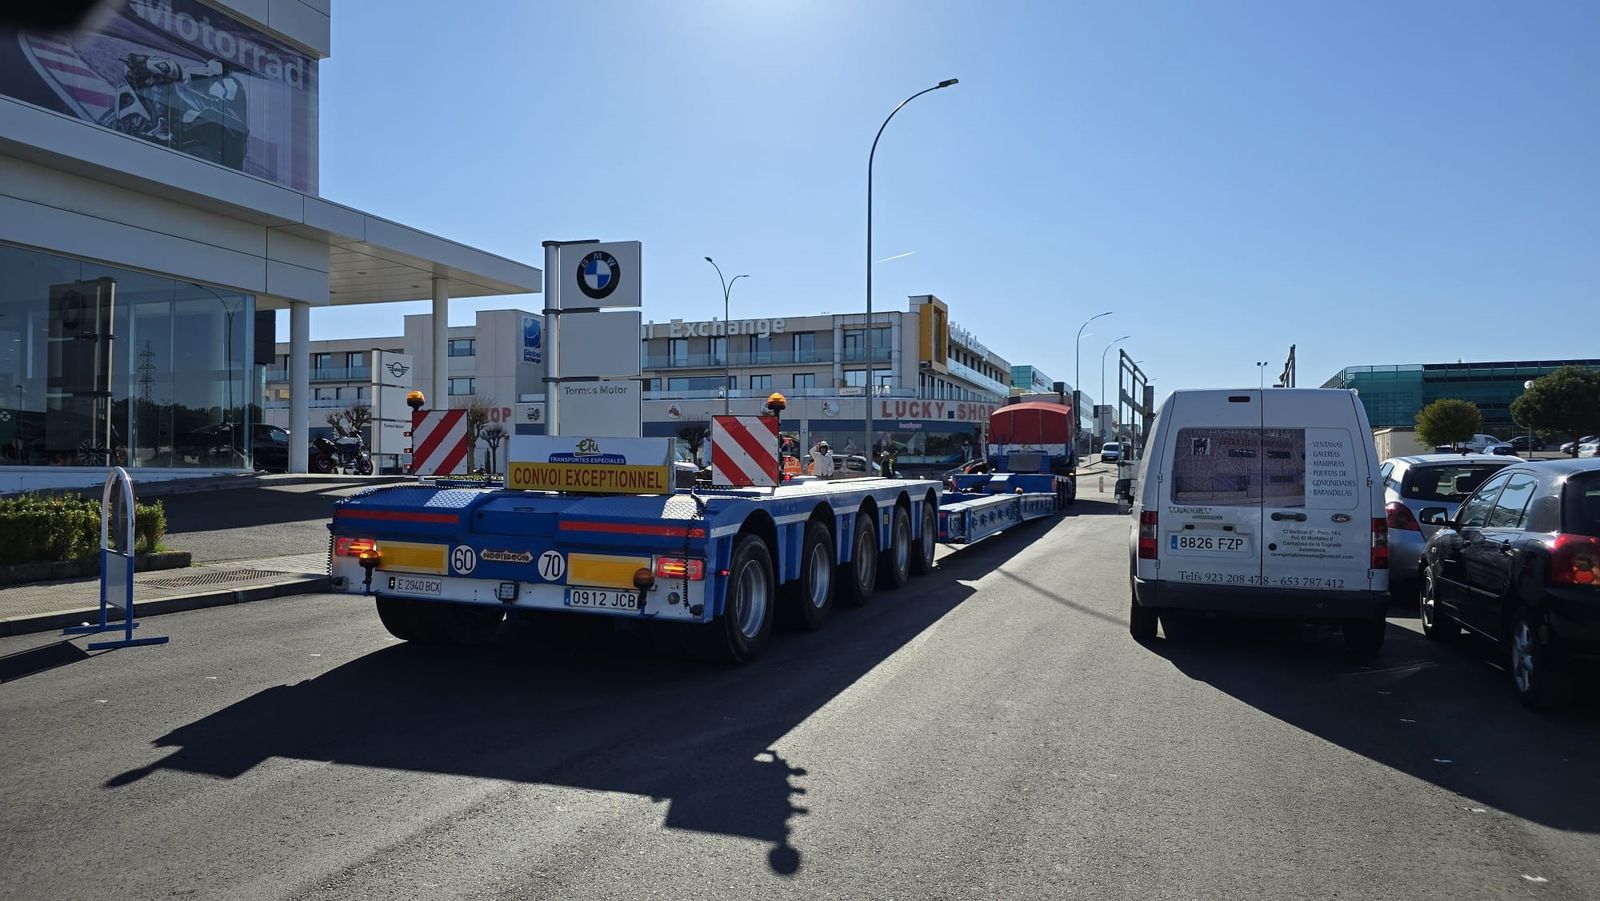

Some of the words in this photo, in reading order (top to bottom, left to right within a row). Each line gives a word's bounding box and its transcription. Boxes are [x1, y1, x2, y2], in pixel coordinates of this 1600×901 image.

[142, 0, 303, 90] Motorrad
[581, 252, 616, 268] BMW
[670, 316, 786, 338] Exchange
[564, 386, 597, 395] Tormes
[600, 386, 628, 394] Motor
[881, 401, 944, 418] LUCKY
[550, 456, 590, 464] TRANSPORTES
[514, 467, 561, 486] CONVOI
[565, 469, 663, 489] EXCEPTIONNEL
[1312, 479, 1357, 487] COMUNIDADES
[1180, 537, 1213, 549] 8826
[1218, 538, 1243, 550] FZP
[454, 548, 473, 571] 60
[543, 554, 561, 578] 70
[405, 578, 424, 592] 2940
[425, 580, 440, 592] BCX
[1178, 571, 1201, 581] Telfs
[1204, 573, 1223, 582] 923
[1226, 575, 1245, 583] 208
[1280, 576, 1299, 586] 653
[1303, 577, 1322, 587] 787
[1325, 578, 1344, 588] 412
[572, 591, 607, 606] 0912
[611, 594, 635, 608] JCB
